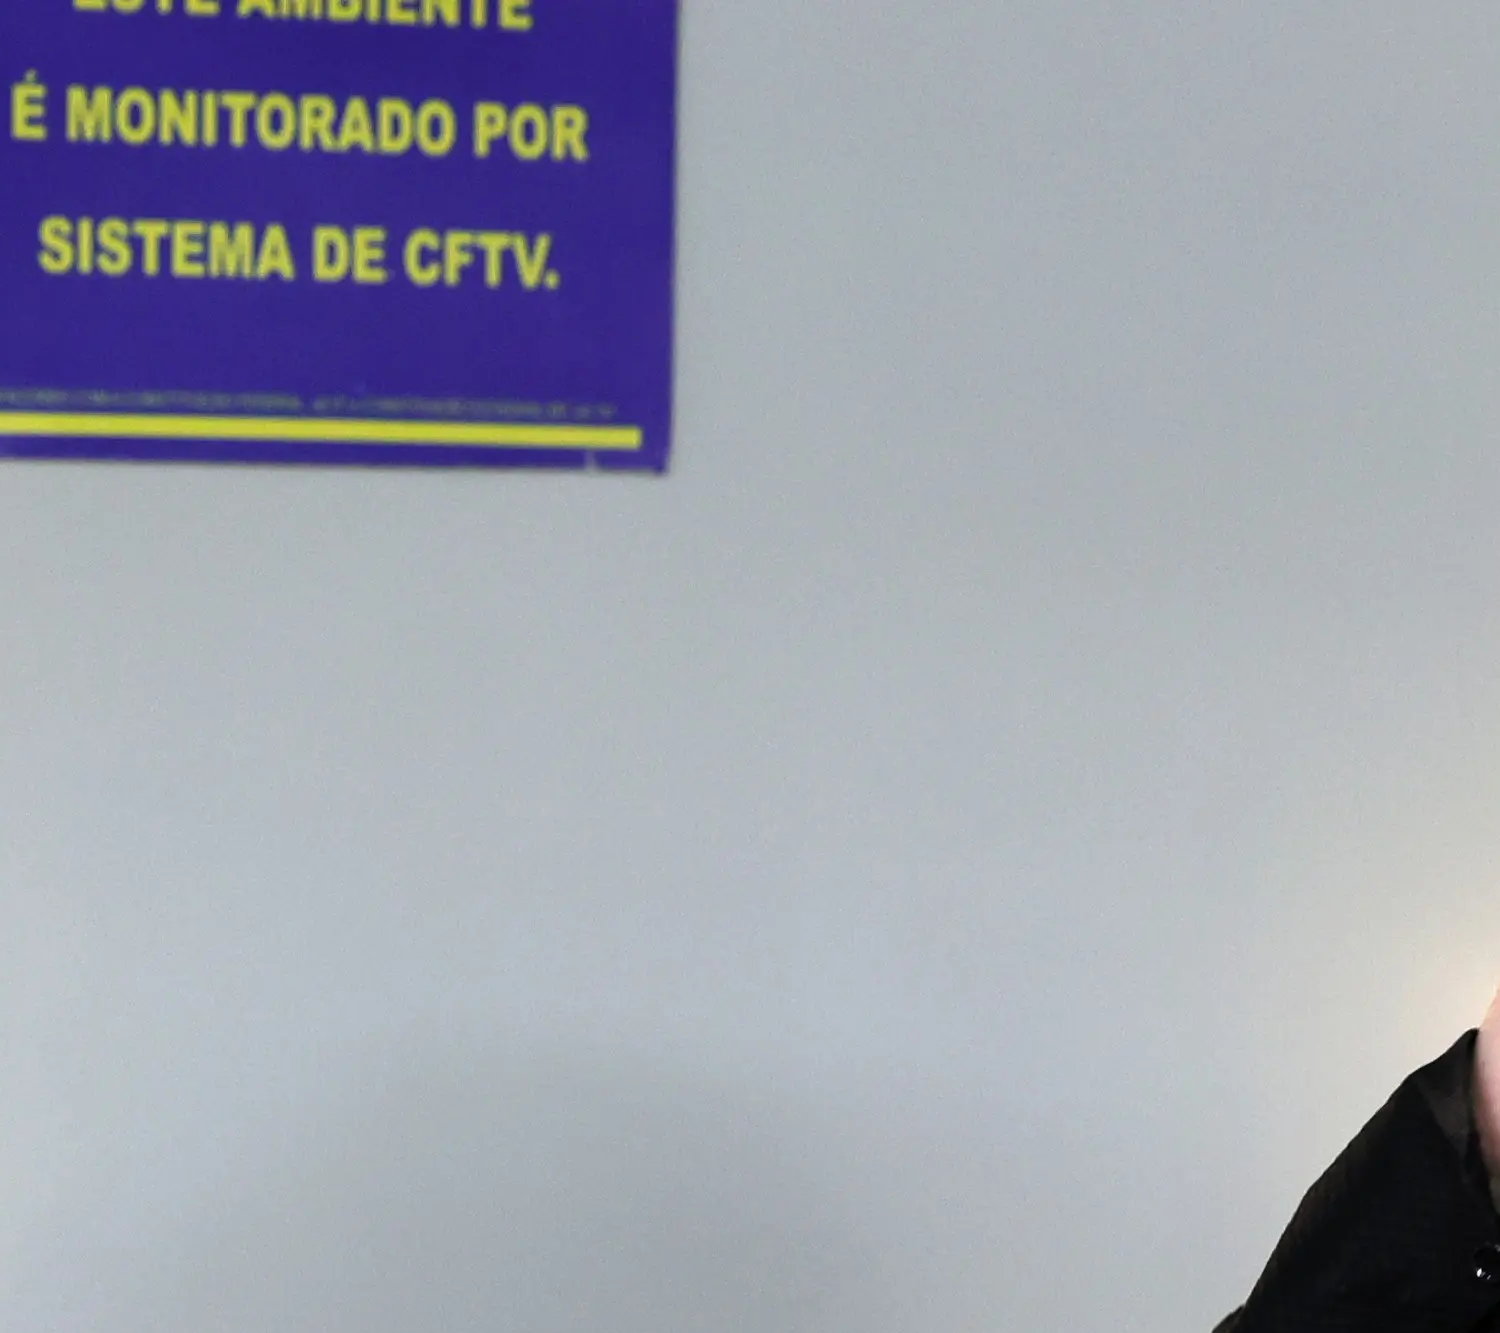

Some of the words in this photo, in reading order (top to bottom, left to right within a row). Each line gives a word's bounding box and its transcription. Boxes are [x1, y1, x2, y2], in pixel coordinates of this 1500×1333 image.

[11, 71, 47, 141] É
[66, 83, 457, 158] MONITORADO
[473, 103, 590, 163] POR
[38, 215, 297, 281] SISTEMA
[313, 225, 389, 285] DE
[404, 228, 561, 290] CFTV.
